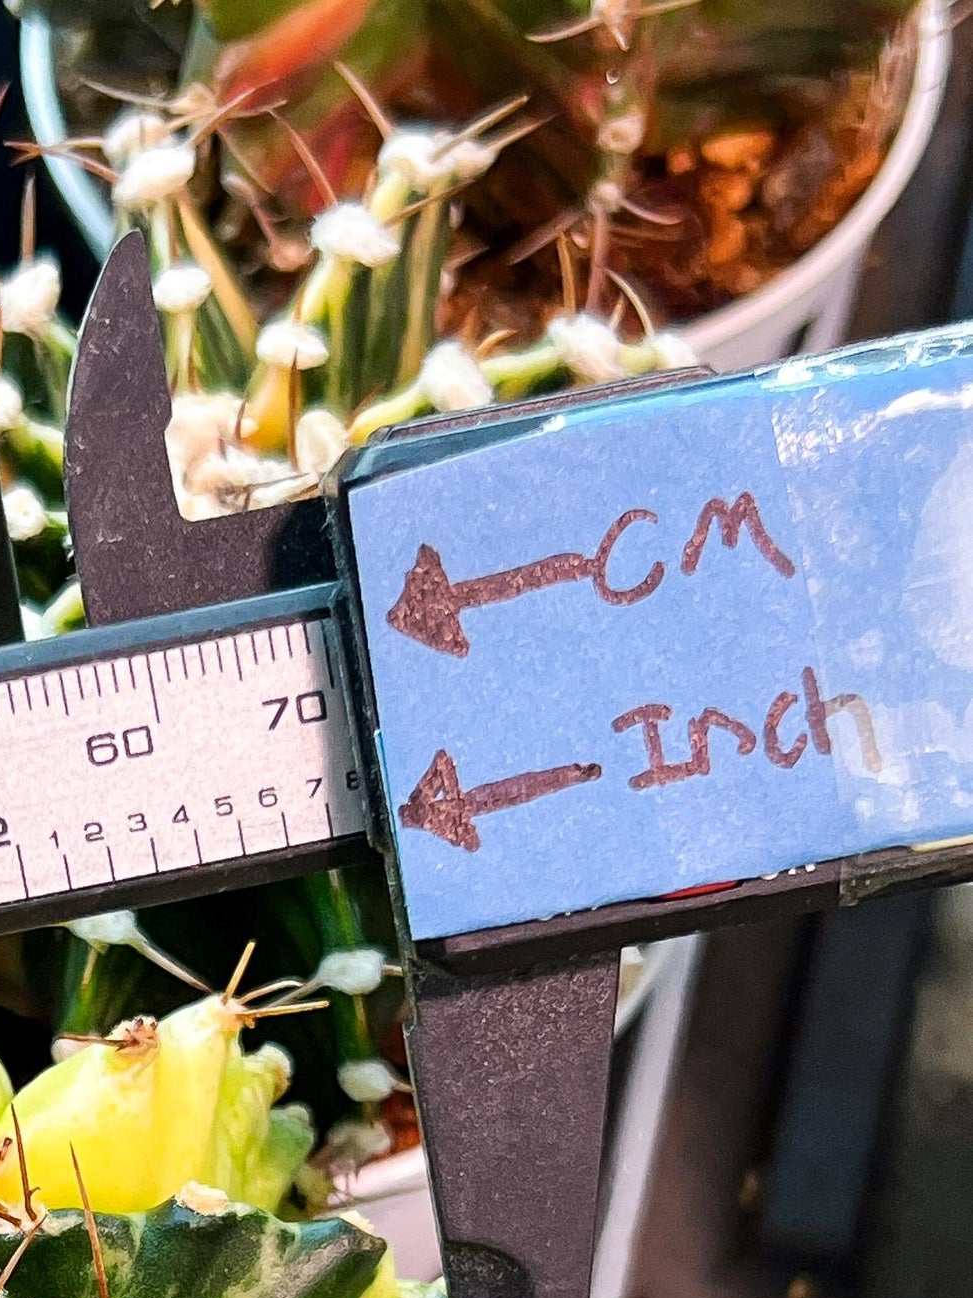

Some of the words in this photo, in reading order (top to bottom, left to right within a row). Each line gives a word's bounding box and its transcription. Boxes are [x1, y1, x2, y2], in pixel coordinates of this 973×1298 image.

[85, 725, 154, 767] 60
[261, 689, 328, 731] 70
[611, 666, 882, 792] Inch
[49, 830, 59, 849] 1
[83, 822, 105, 842] 2
[127, 812, 148, 833] 3
[172, 804, 190, 824] 4
[214, 795, 233, 817] 5
[258, 786, 278, 808] 6
[306, 777, 323, 798] 7
